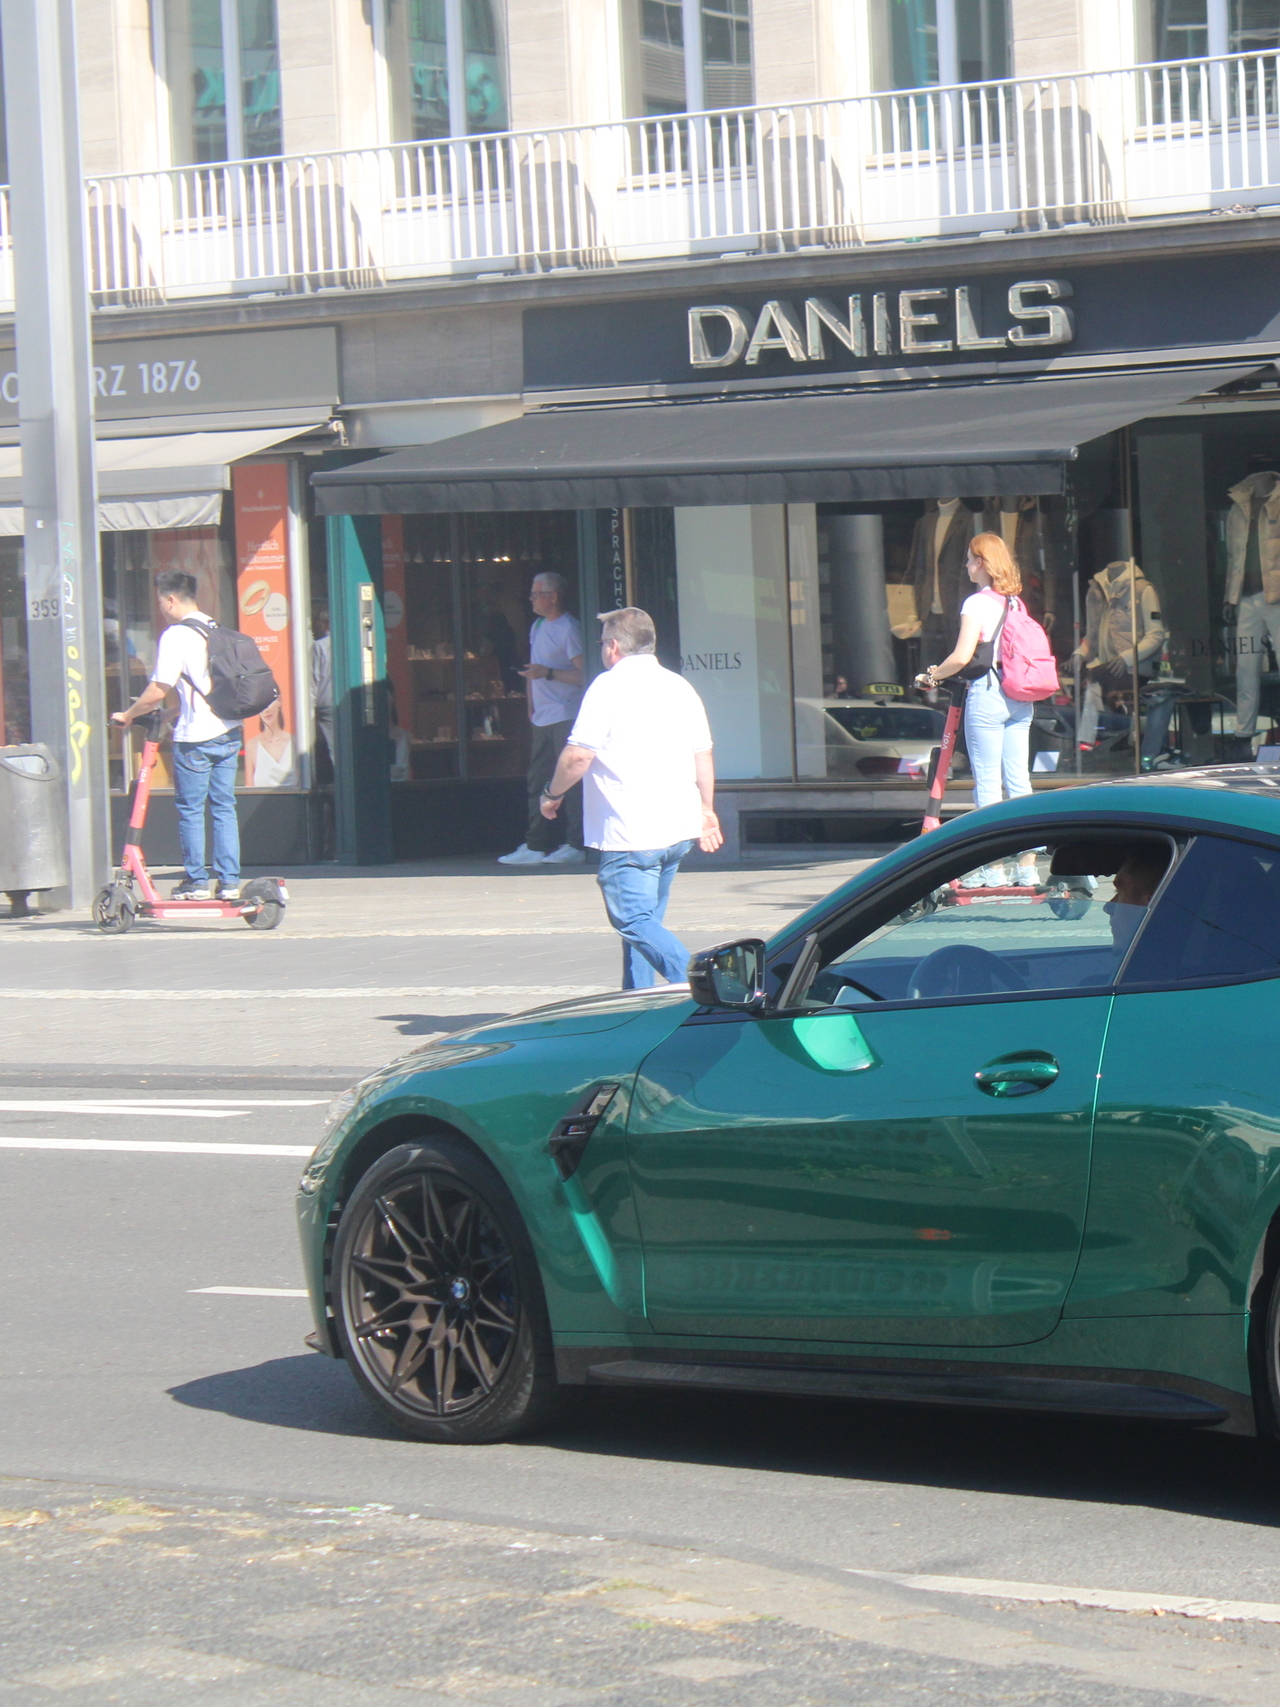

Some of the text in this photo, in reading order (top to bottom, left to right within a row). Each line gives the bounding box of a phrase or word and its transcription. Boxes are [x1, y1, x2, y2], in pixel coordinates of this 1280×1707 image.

[688, 279, 1074, 368] DANIELS
[138, 359, 201, 394] 1876
[31, 600, 60, 619] 359
